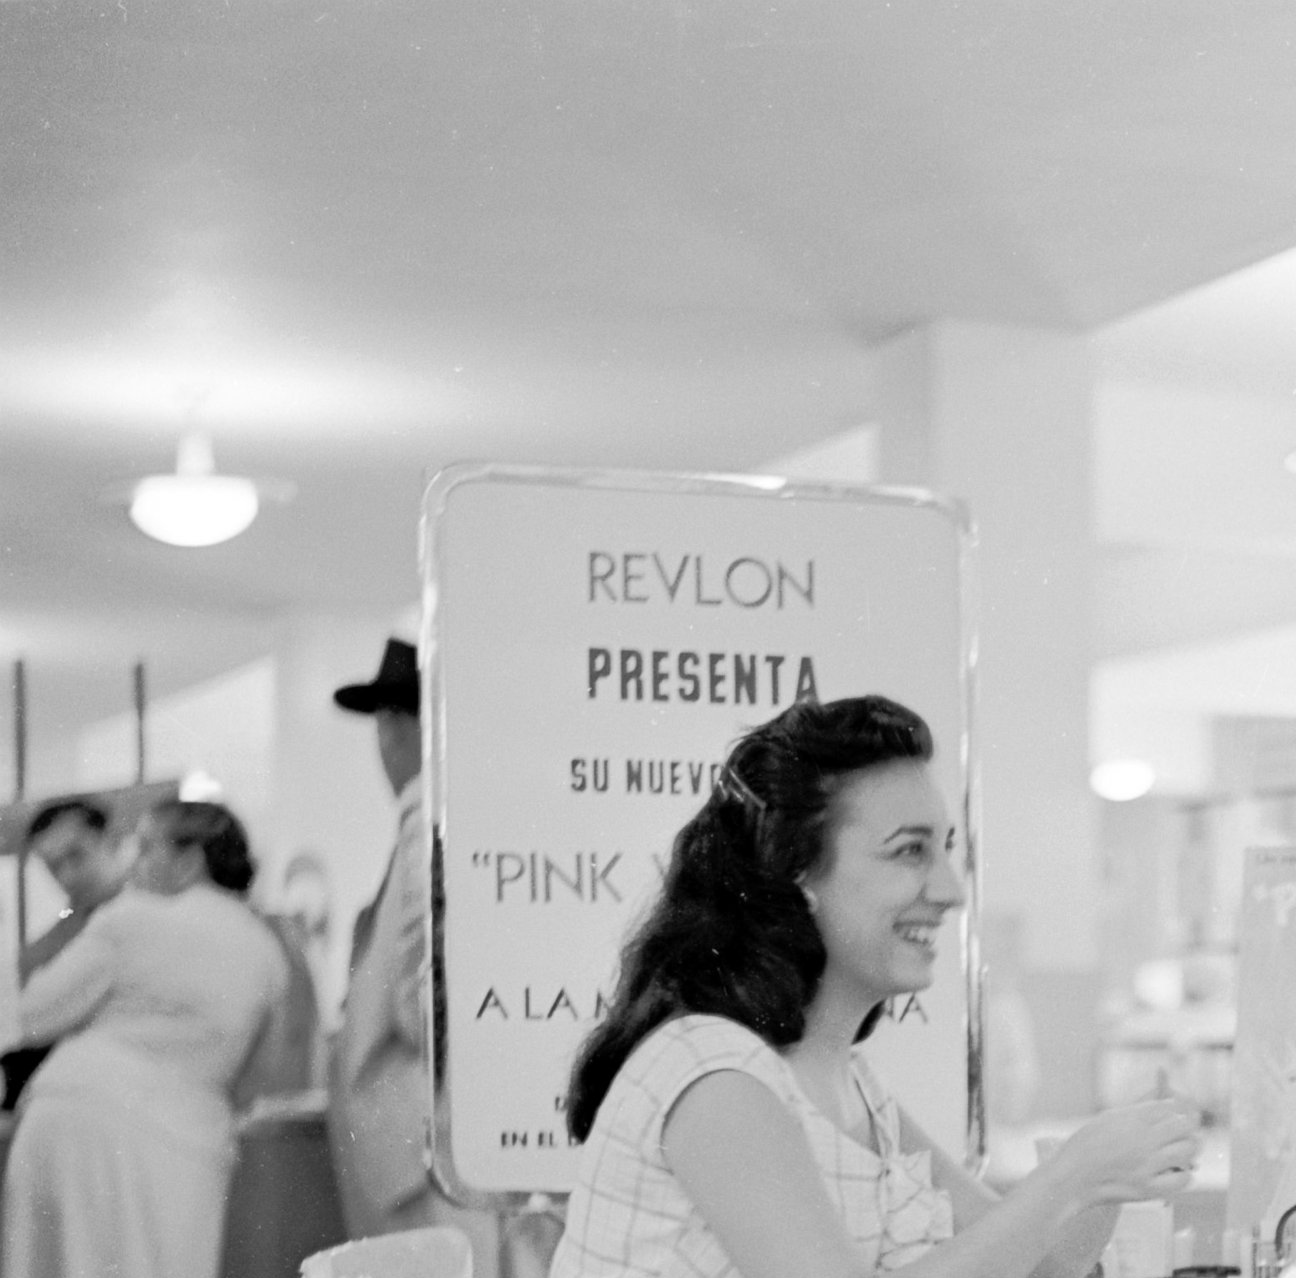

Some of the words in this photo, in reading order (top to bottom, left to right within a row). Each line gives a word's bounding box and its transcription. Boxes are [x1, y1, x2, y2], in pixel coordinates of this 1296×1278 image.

[587, 551, 816, 609] REVLON
[587, 647, 820, 706] PRESENTA
[570, 758, 609, 792] SU
[475, 986, 509, 1021] A
[523, 986, 577, 1021] LA
